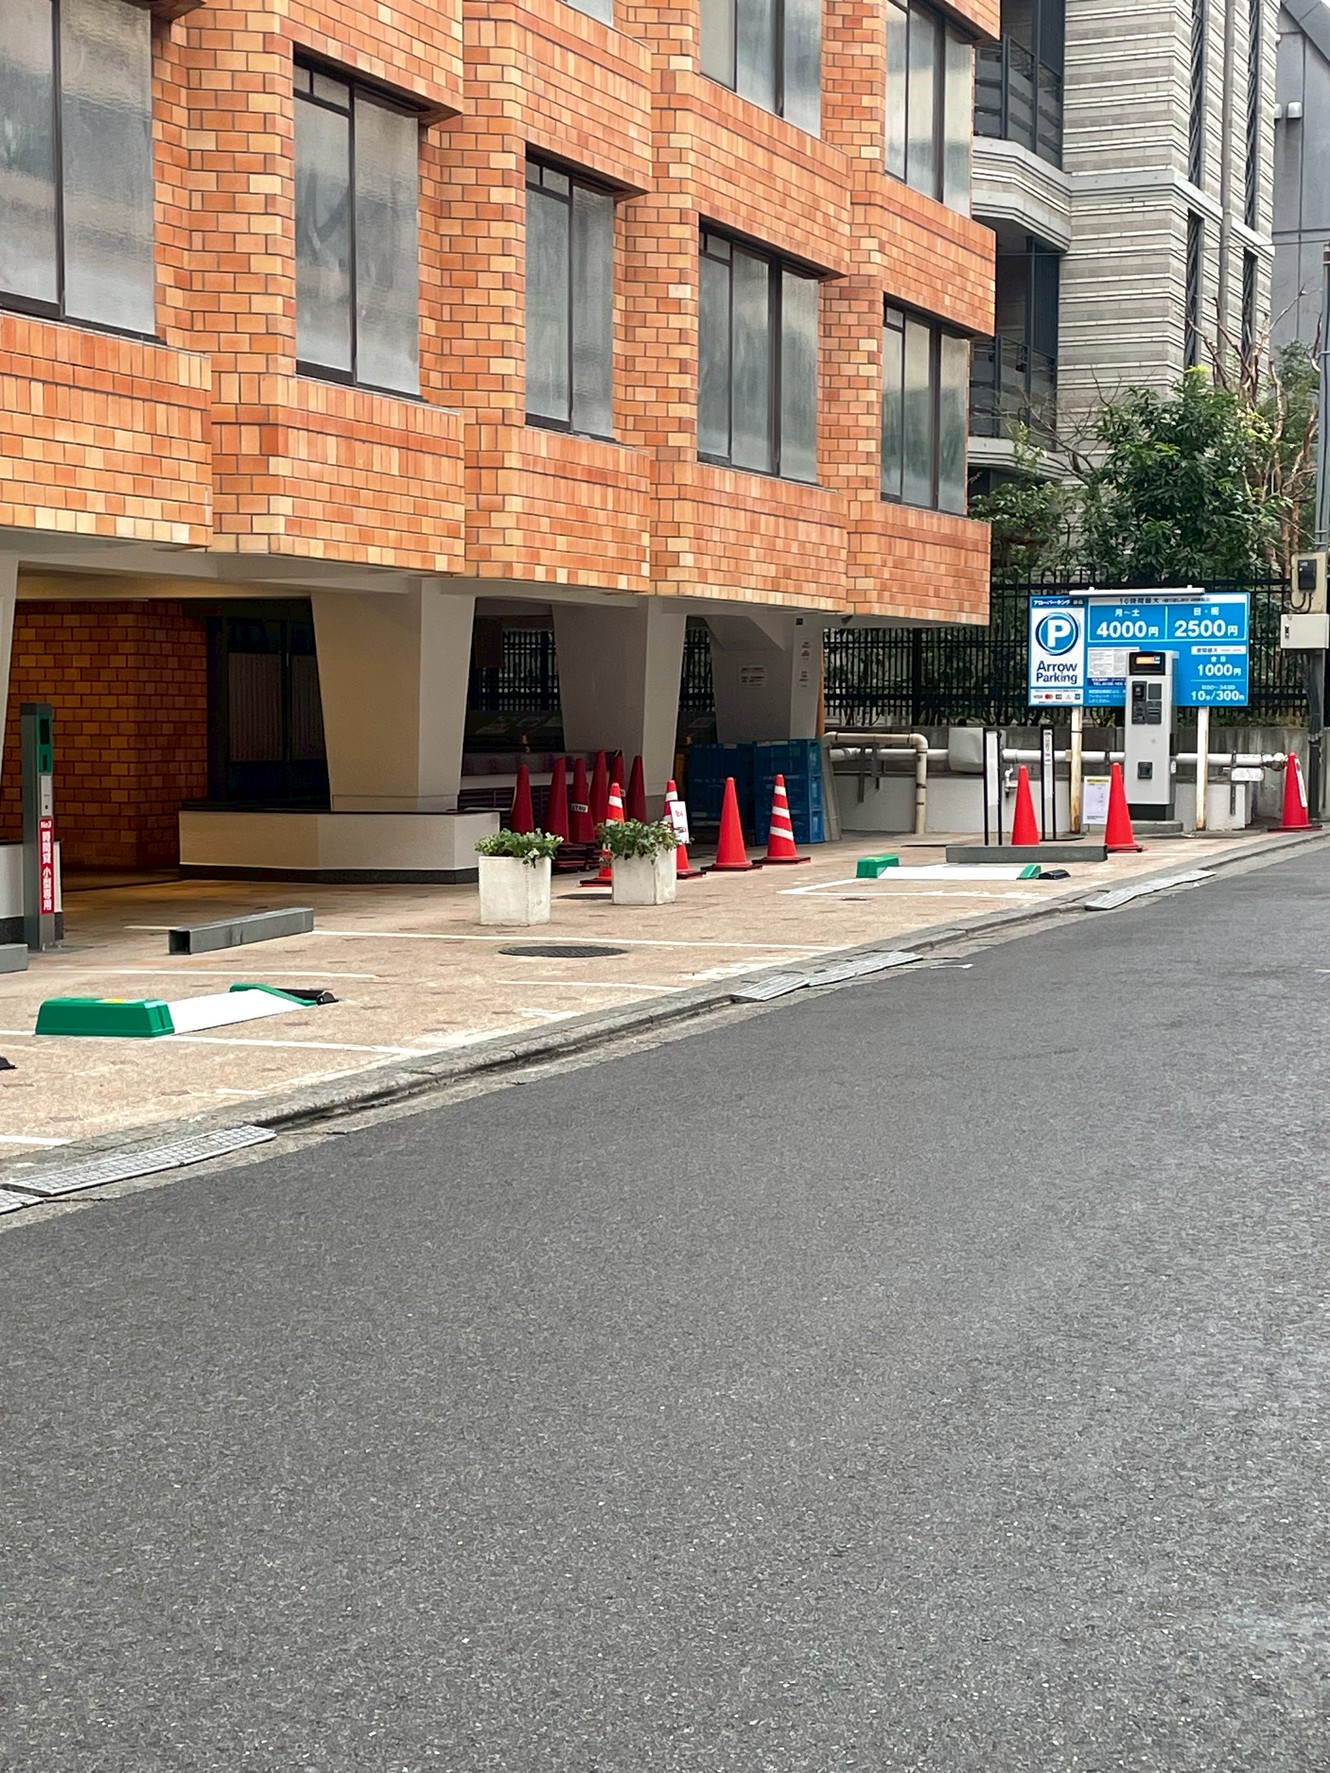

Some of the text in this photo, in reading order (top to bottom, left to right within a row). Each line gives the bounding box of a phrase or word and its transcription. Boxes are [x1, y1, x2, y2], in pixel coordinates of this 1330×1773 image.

[1047, 619, 1071, 648] P
[1096, 620, 1159, 638] 4000円
[1174, 619, 1239, 637] 2500円
[1036, 660, 1078, 672] Arrow
[1197, 663, 1242, 677] 1000円
[1036, 672, 1078, 685] Parking
